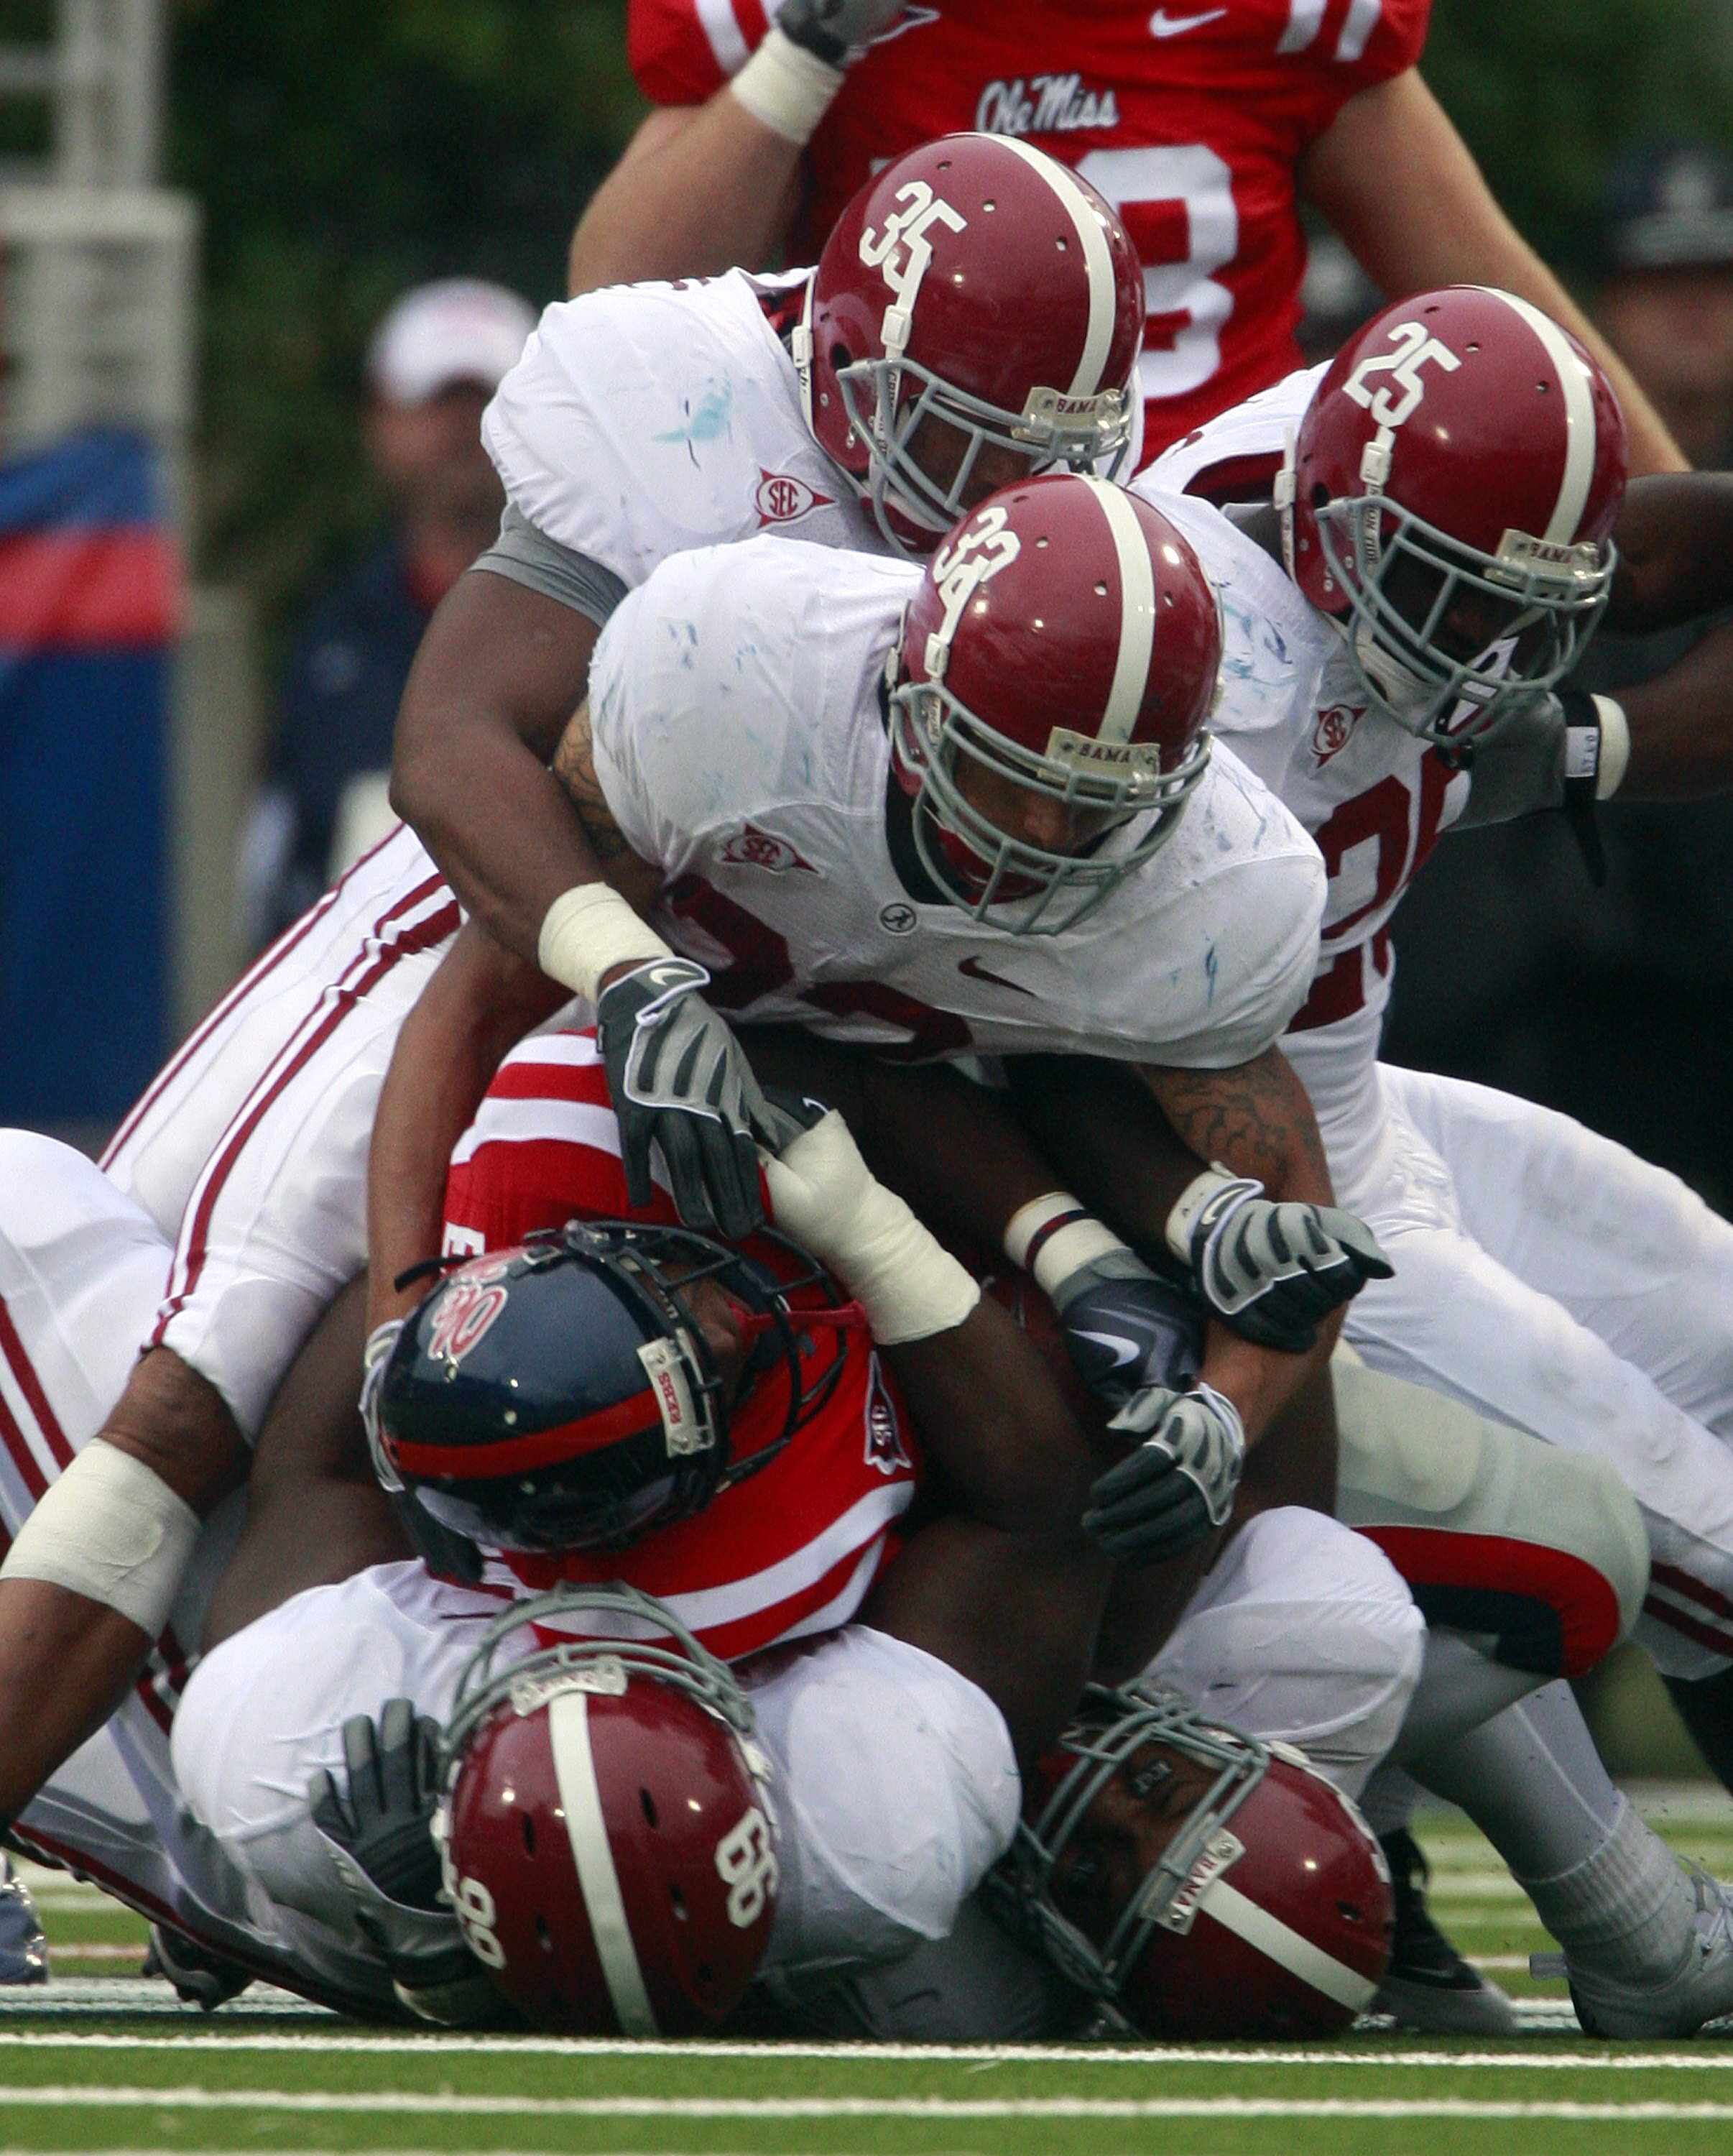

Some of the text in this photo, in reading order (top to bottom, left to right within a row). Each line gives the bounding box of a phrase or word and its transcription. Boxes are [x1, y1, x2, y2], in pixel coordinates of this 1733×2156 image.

[974, 71, 1121, 136] Ole Miss
[859, 180, 967, 293] 35
[1341, 321, 1461, 428] 25
[1057, 398, 1098, 414] BAMA
[768, 479, 799, 517] SEC
[1079, 742, 1132, 764] BAMA
